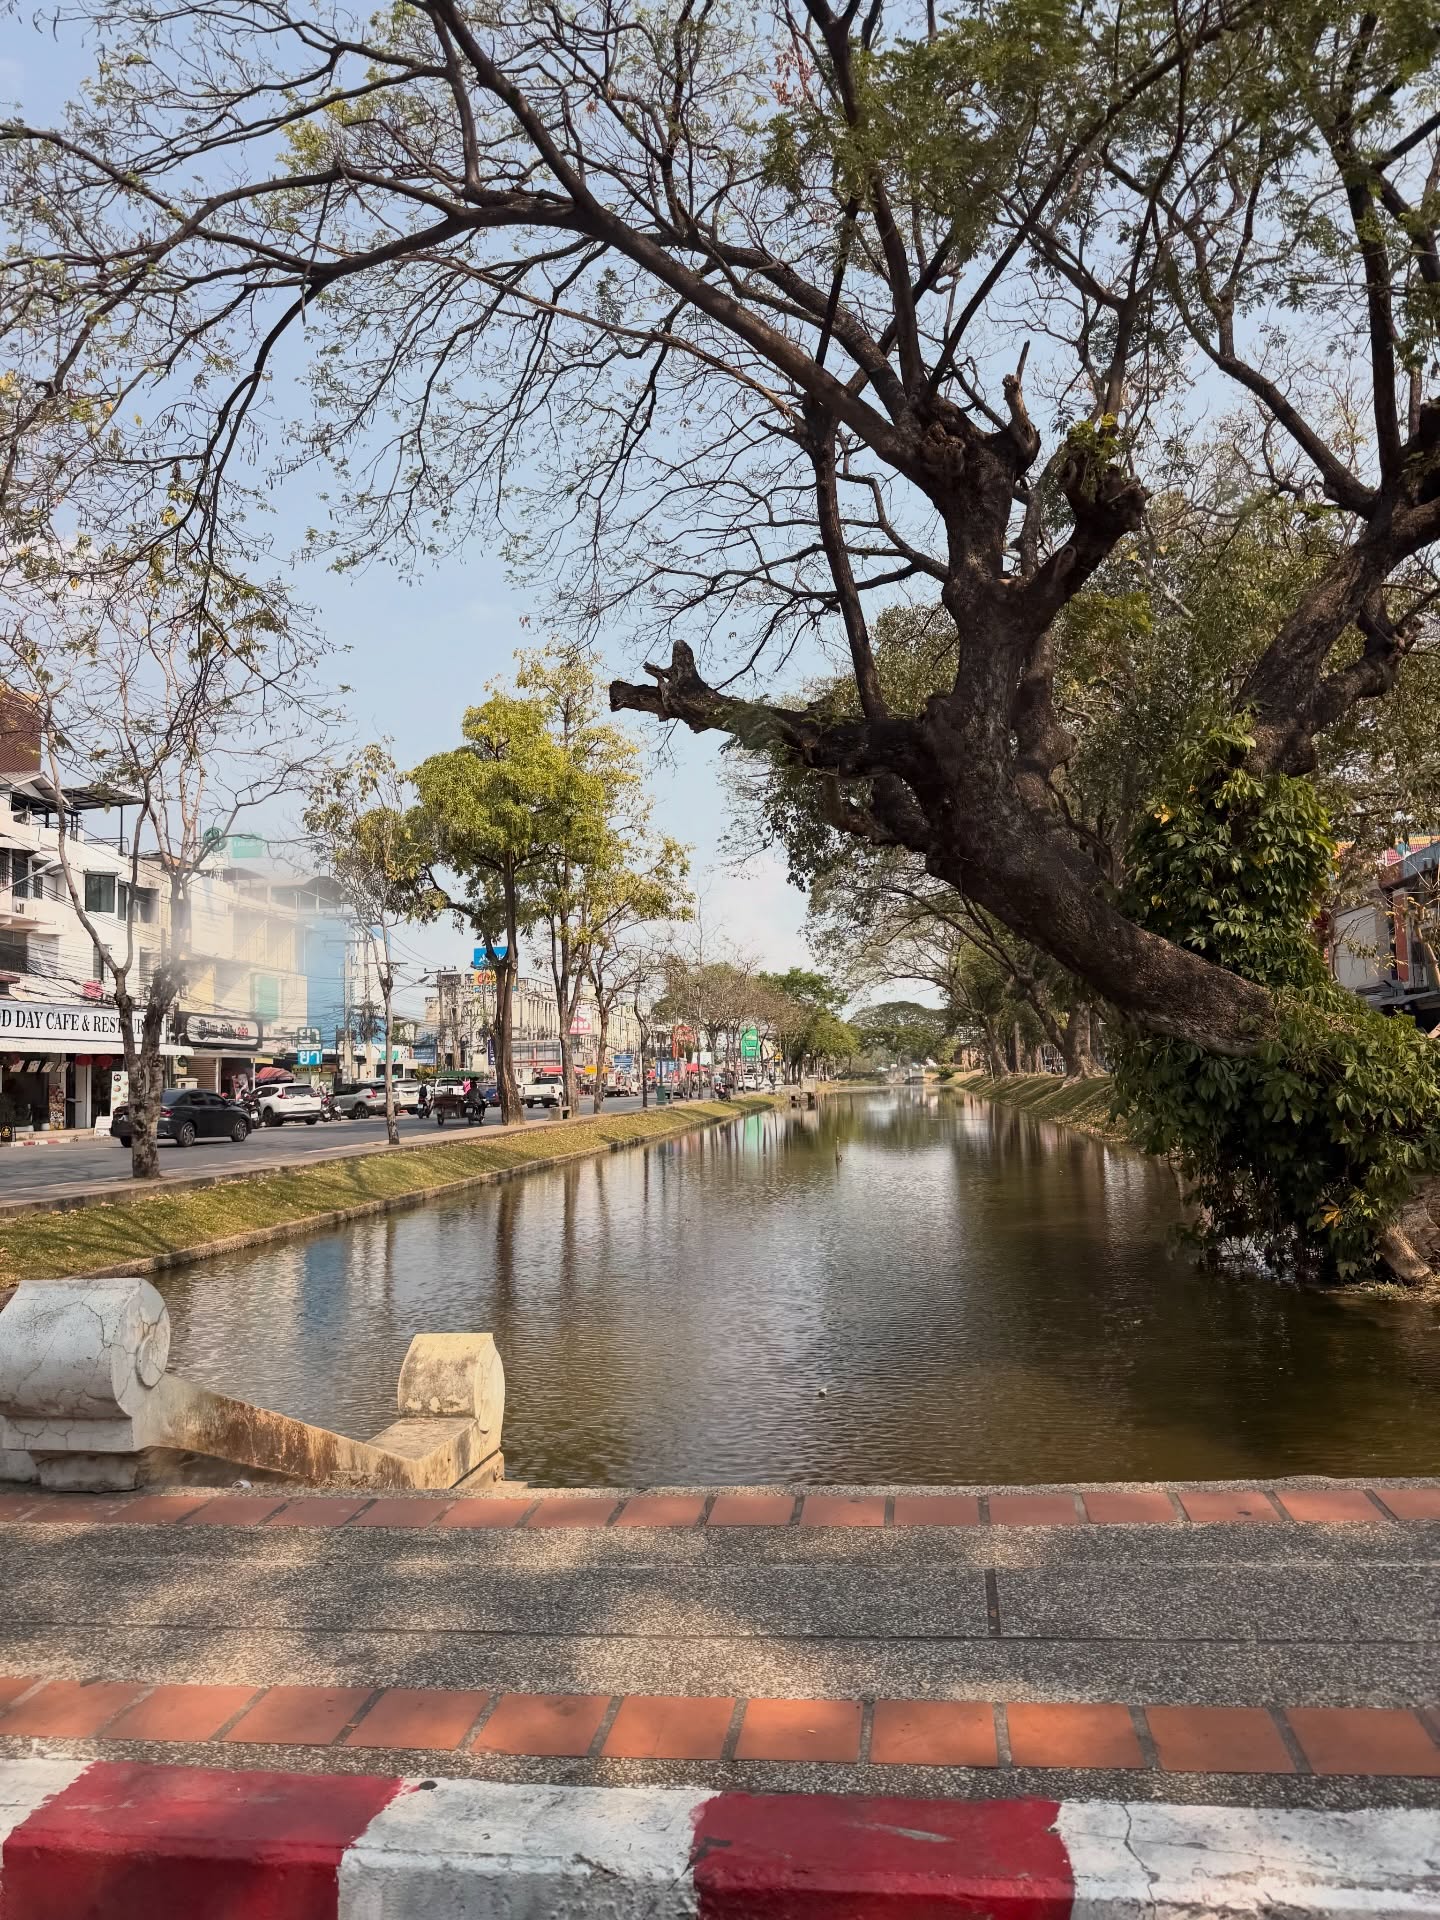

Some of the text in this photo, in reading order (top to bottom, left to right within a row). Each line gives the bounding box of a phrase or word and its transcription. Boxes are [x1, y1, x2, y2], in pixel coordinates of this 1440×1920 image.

[0, 1009, 12, 1027] D
[15, 1010, 43, 1029] DAY
[46, 1012, 80, 1031] CAFE
[82, 1015, 90, 1032] &
[299, 1050, 320, 1065] ยา
